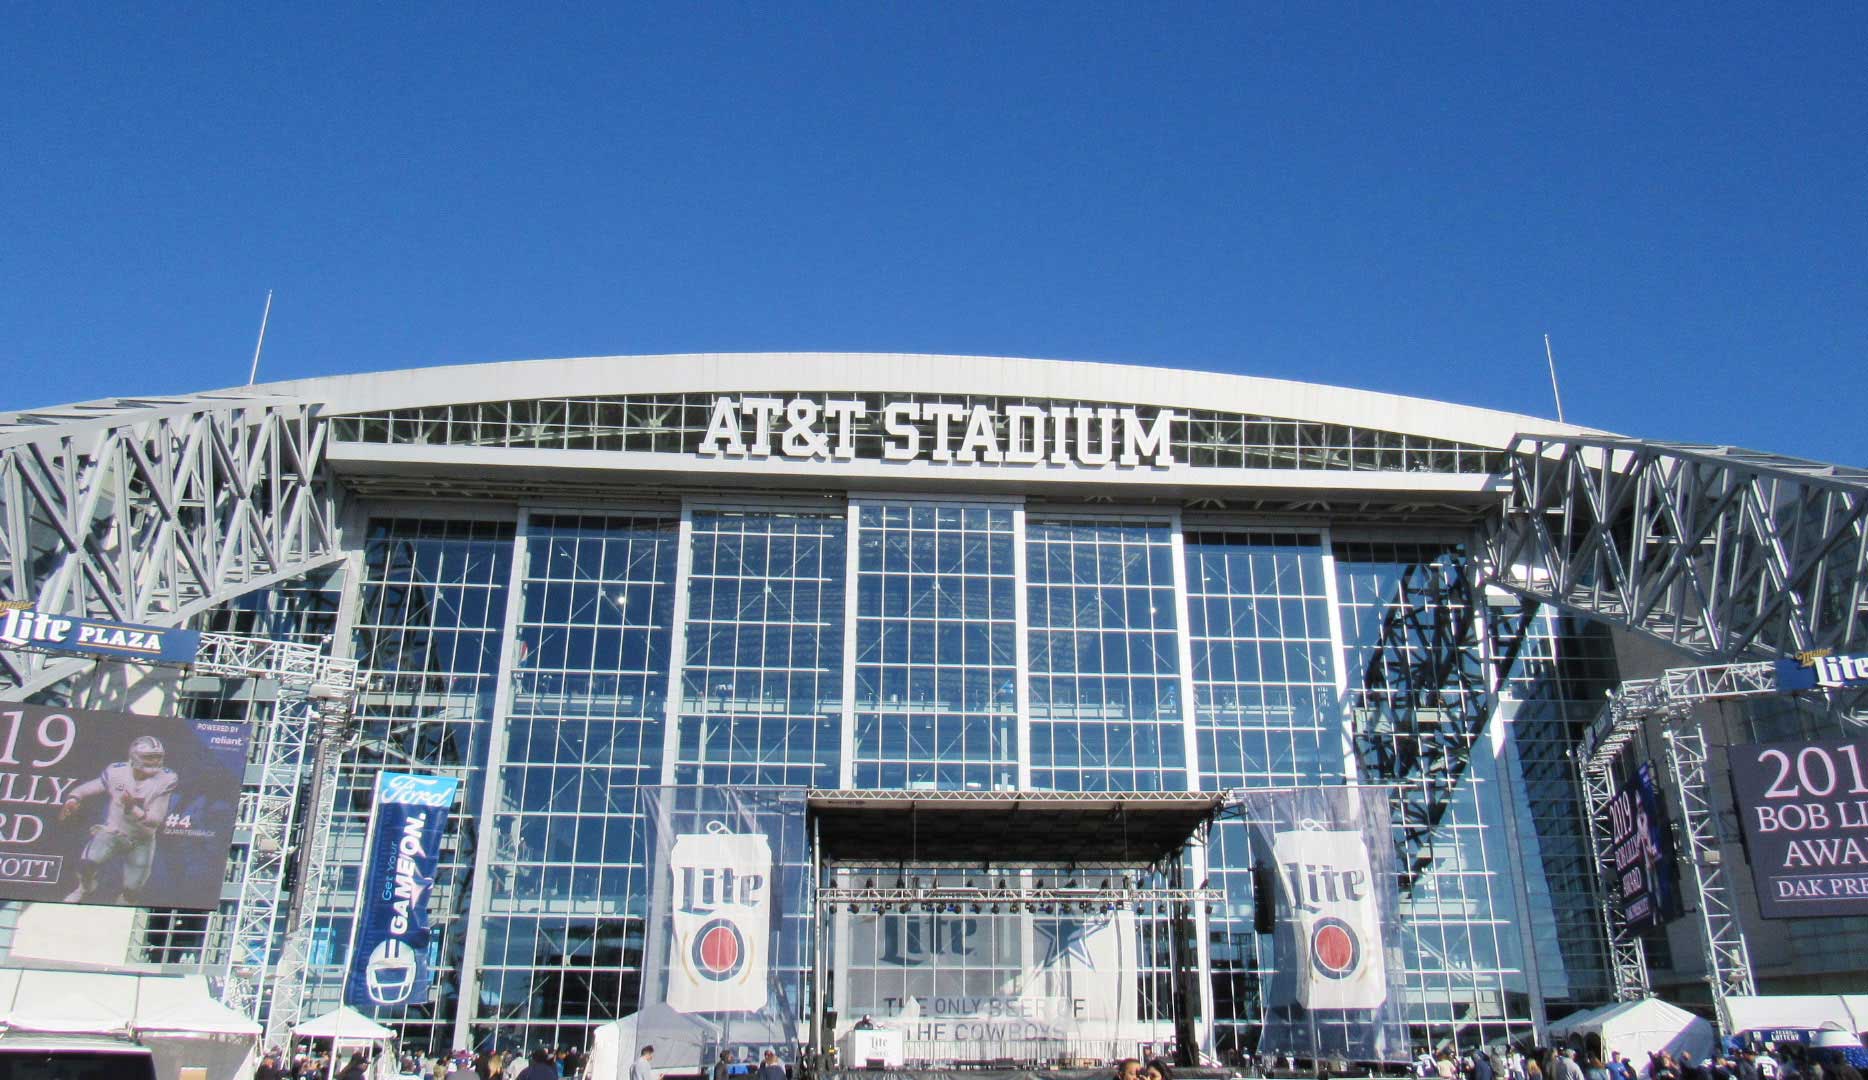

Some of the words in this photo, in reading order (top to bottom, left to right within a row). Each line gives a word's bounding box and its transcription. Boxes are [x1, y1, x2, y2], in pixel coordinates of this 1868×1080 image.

[698, 396, 866, 457] AT&T
[884, 403, 1174, 466] STADIUM
[78, 626, 162, 649] PLAZA
[197, 723, 229, 732] POWERED
[211, 735, 243, 747] reliant
[382, 775, 453, 807] Ford
[166, 813, 192, 828] #4
[1609, 790, 1633, 845] 2019
[1754, 803, 1829, 832] BOB
[386, 841, 398, 872] Your
[382, 875, 394, 901] Get
[678, 865, 764, 916] Lite
[1282, 861, 1366, 914] Lite
[1776, 879, 1827, 897] DAK
[934, 998, 981, 1015] ONLY
[955, 1022, 1067, 1042] COWBOYS
